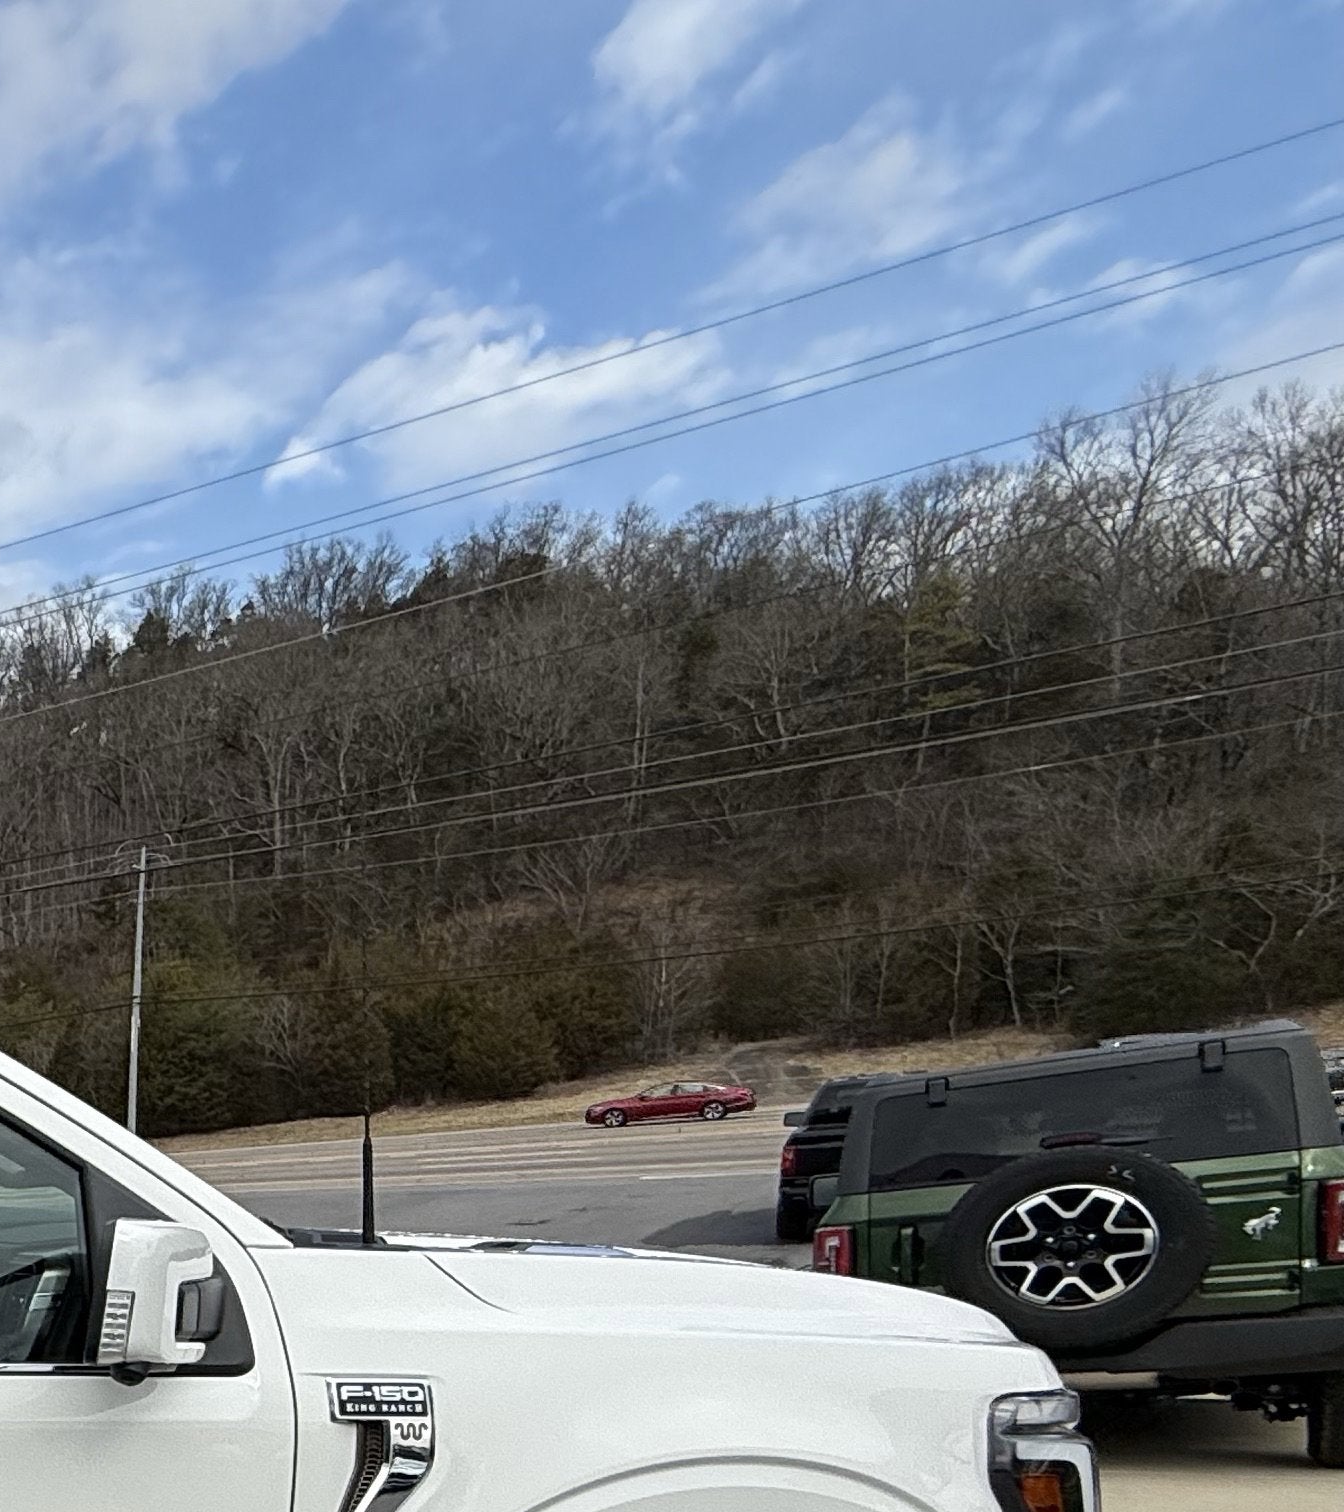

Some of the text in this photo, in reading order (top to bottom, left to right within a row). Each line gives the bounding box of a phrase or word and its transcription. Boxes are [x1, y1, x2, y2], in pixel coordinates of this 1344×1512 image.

[340, 1385, 425, 1402] F-150
[346, 1402, 423, 1413] KING RANCH
